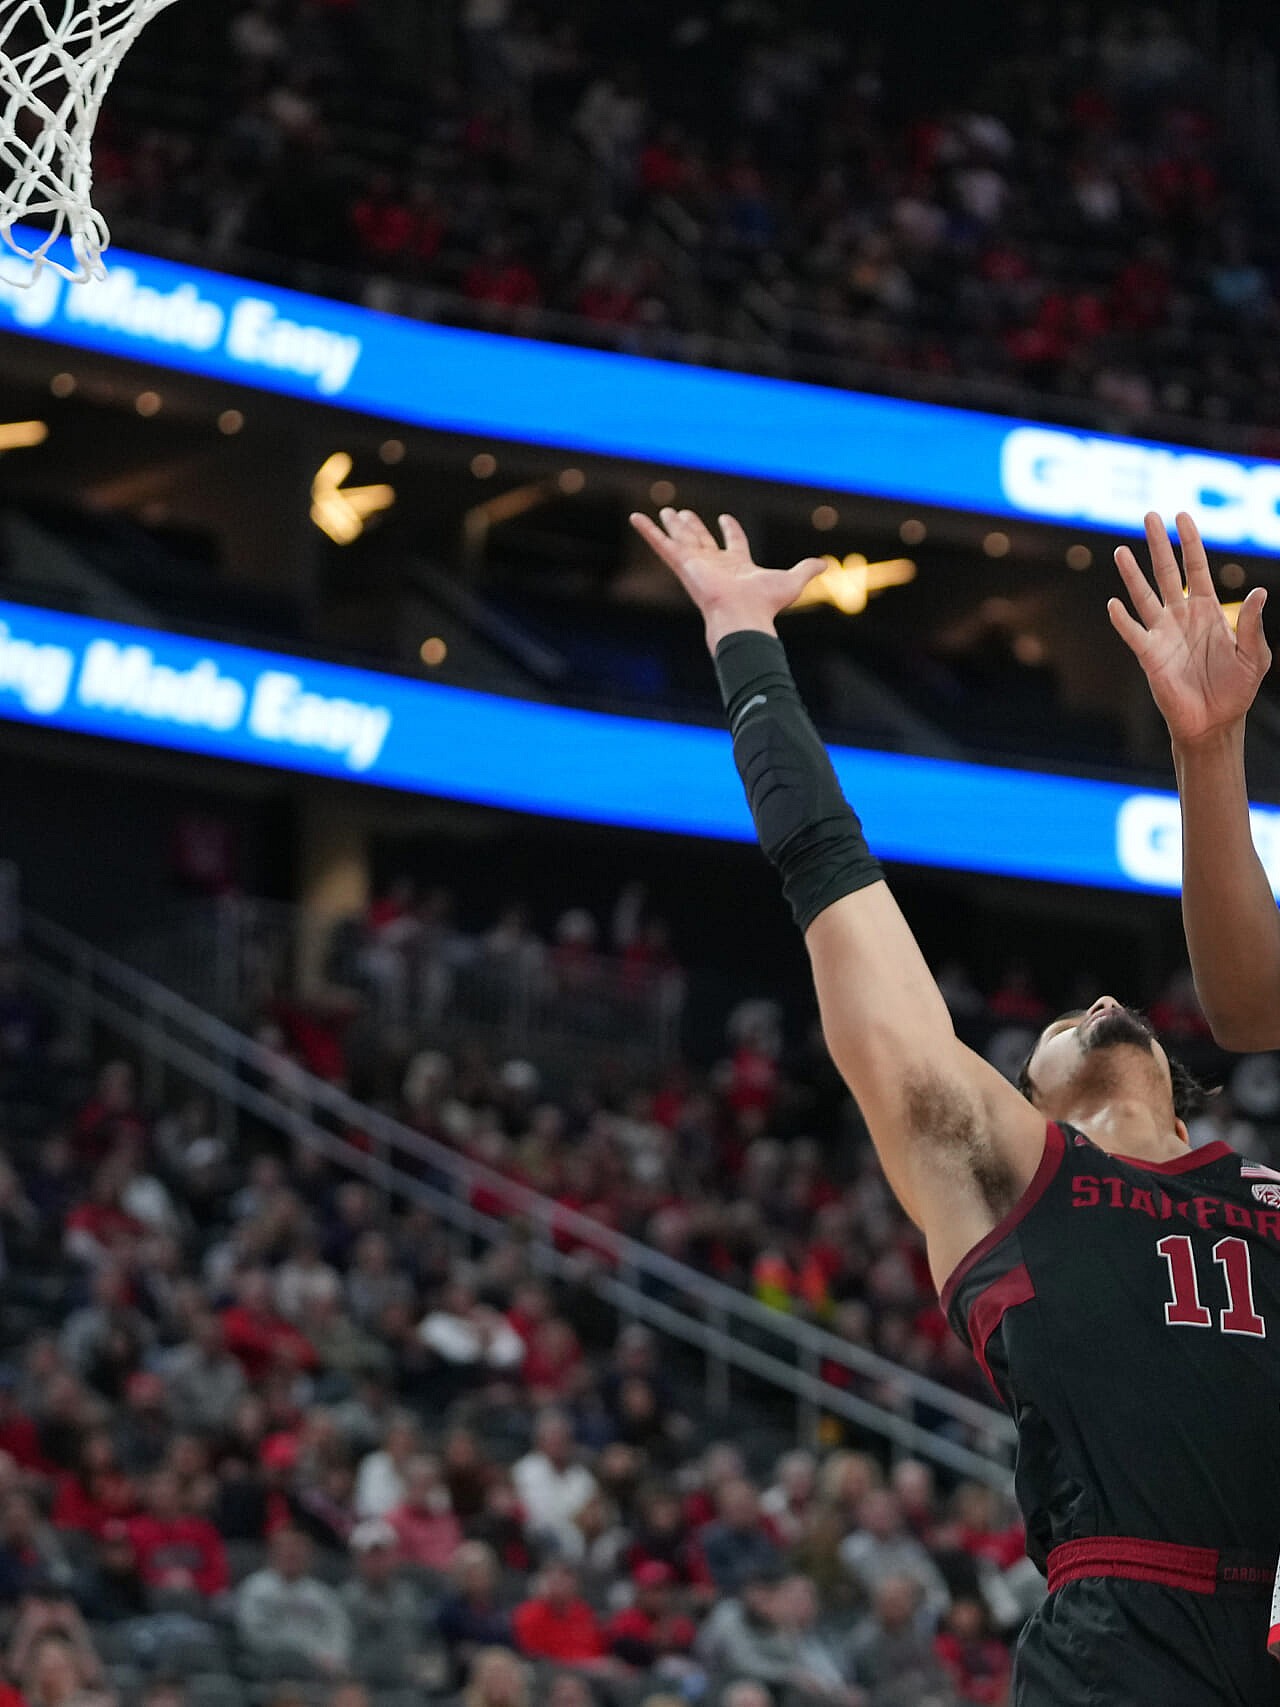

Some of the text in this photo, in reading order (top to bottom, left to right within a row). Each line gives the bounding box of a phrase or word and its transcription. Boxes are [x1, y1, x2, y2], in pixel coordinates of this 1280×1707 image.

[65, 264, 224, 351] Made
[226, 297, 361, 396] Easy
[77, 638, 246, 732] Made
[248, 670, 392, 772] Easy
[1156, 1234, 1266, 1338] 11
